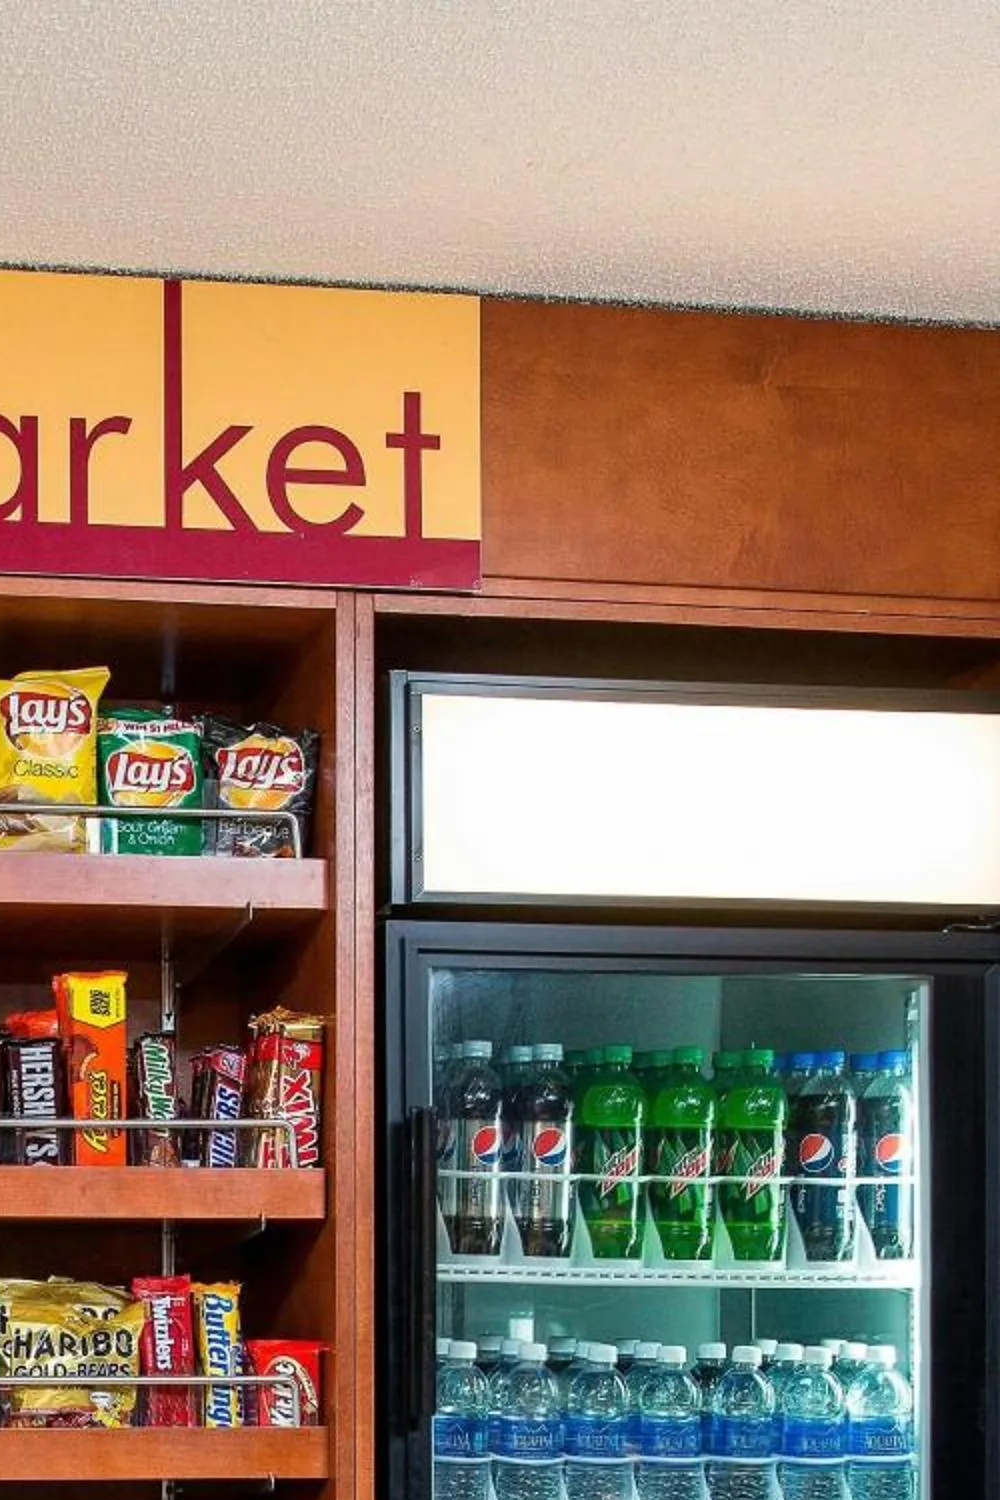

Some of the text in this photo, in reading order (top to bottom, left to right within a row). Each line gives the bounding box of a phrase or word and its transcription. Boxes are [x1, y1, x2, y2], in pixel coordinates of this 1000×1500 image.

[9, 694, 89, 735] Lay's
[13, 759, 79, 779] Classic
[111, 753, 189, 792] Lay's
[219, 751, 300, 791] Lay's
[137, 833, 175, 846] Onion
[19, 1046, 59, 1157] HERSHY'S
[82, 1070, 109, 1153] Rese's
[13, 1327, 134, 1359] HARIBO
[151, 1296, 175, 1370] Twizzlers
[13, 1363, 131, 1378] GOLD-BEARS
